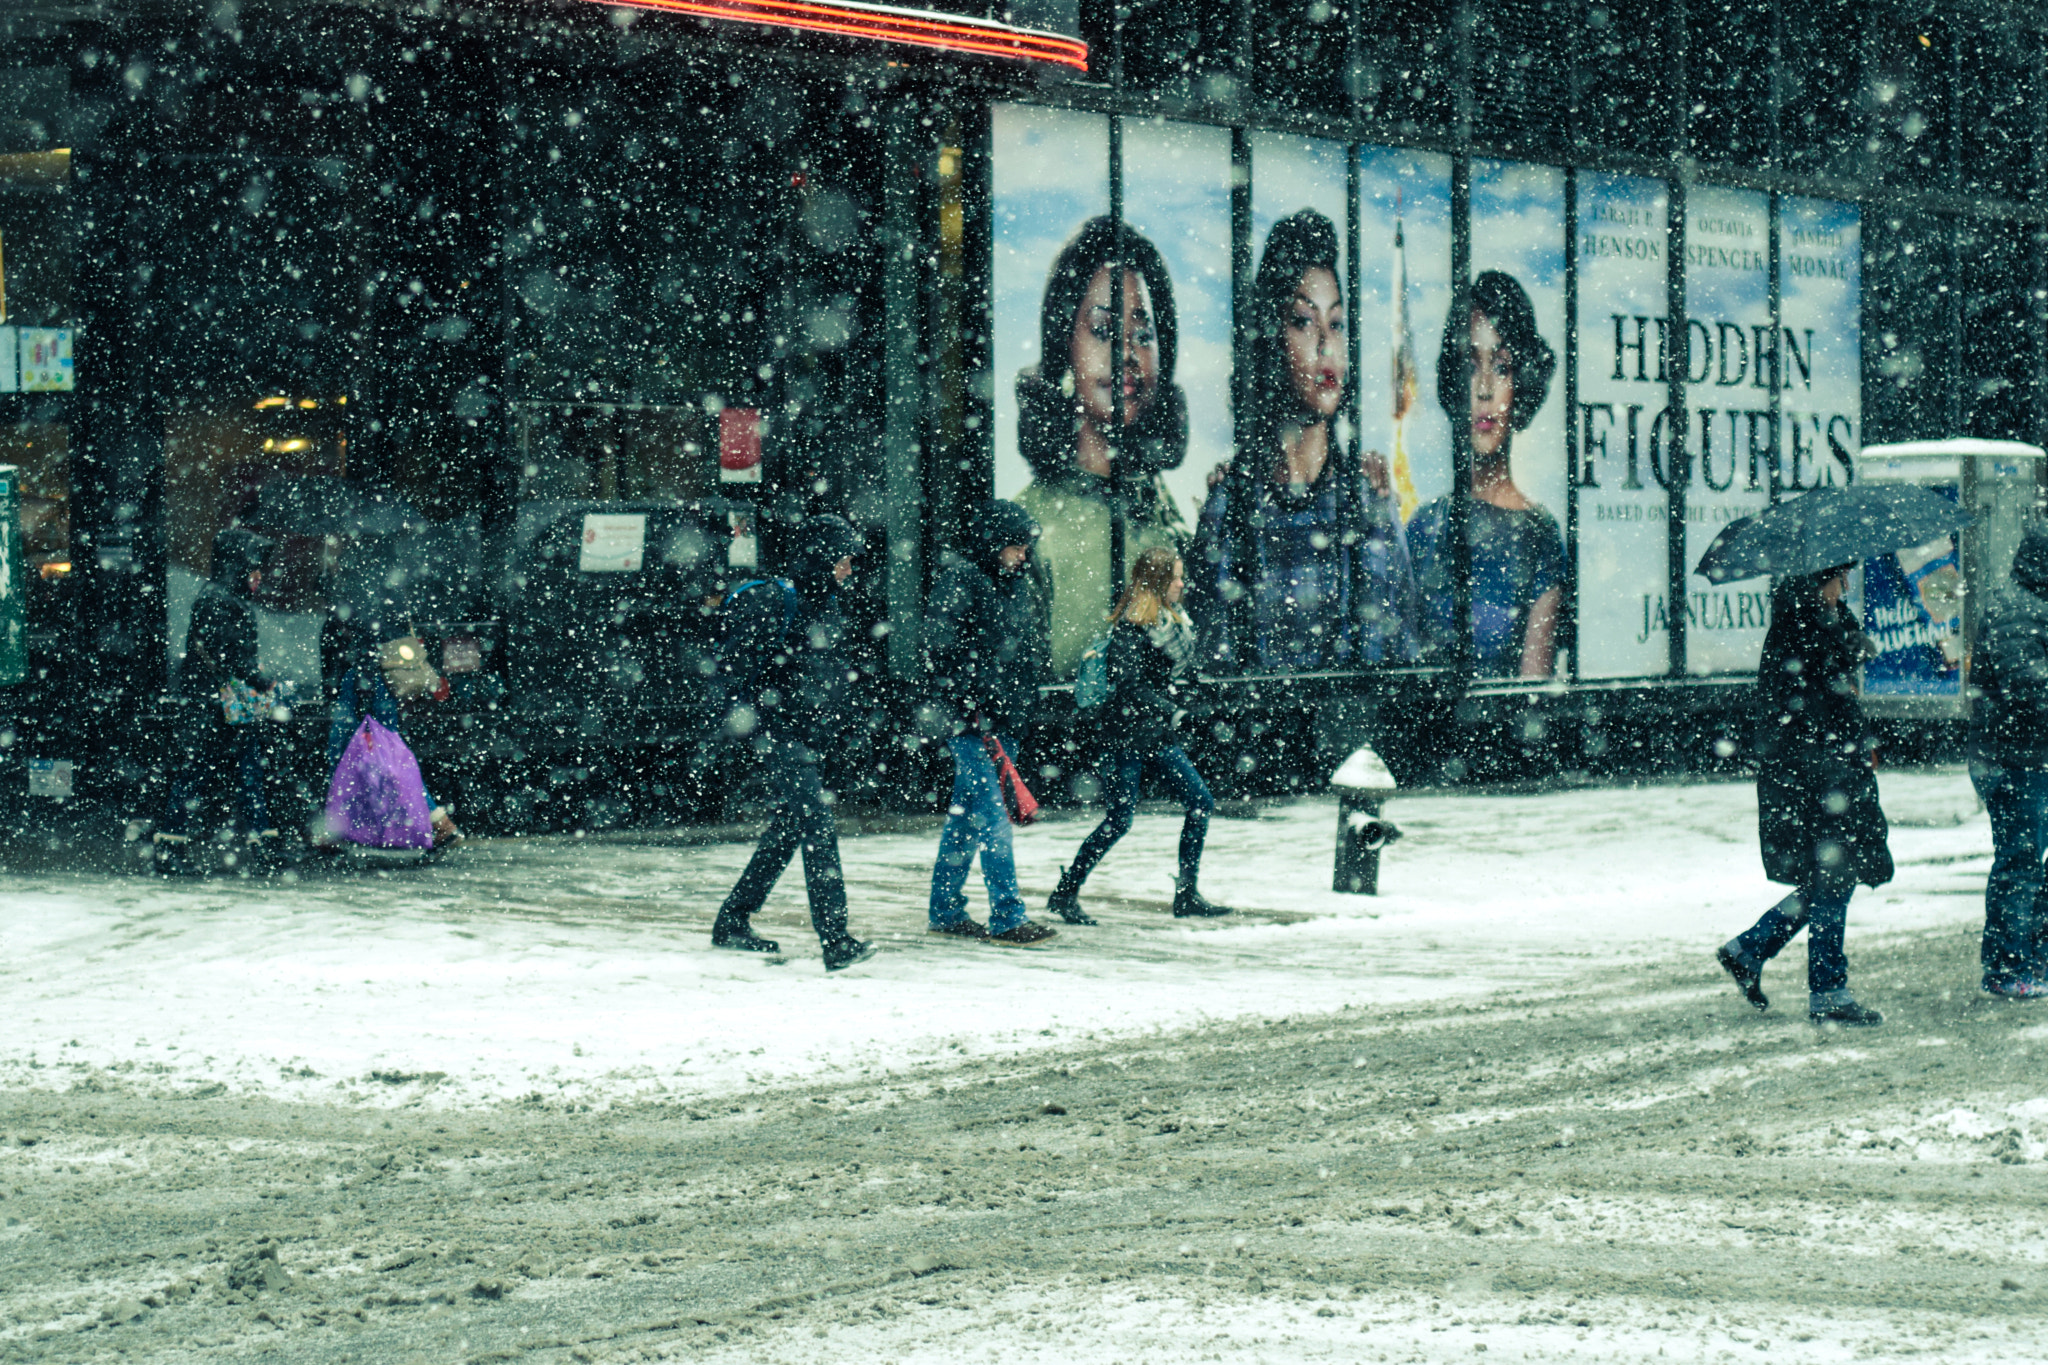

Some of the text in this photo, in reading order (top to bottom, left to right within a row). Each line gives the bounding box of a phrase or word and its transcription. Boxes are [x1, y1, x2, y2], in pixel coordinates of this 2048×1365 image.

[1697, 217, 1753, 238] OCTAVIA
[1583, 234, 1660, 261] HENSON
[1687, 244, 1764, 272] SPENCER
[1611, 314, 1815, 391] HIDDEN
[1574, 402, 1854, 492] FIGURES
[1597, 503, 1643, 522] BASED
[1648, 504, 1668, 522] ON
[1637, 591, 1771, 644] JANUARY
[1874, 597, 1919, 629] Hello
